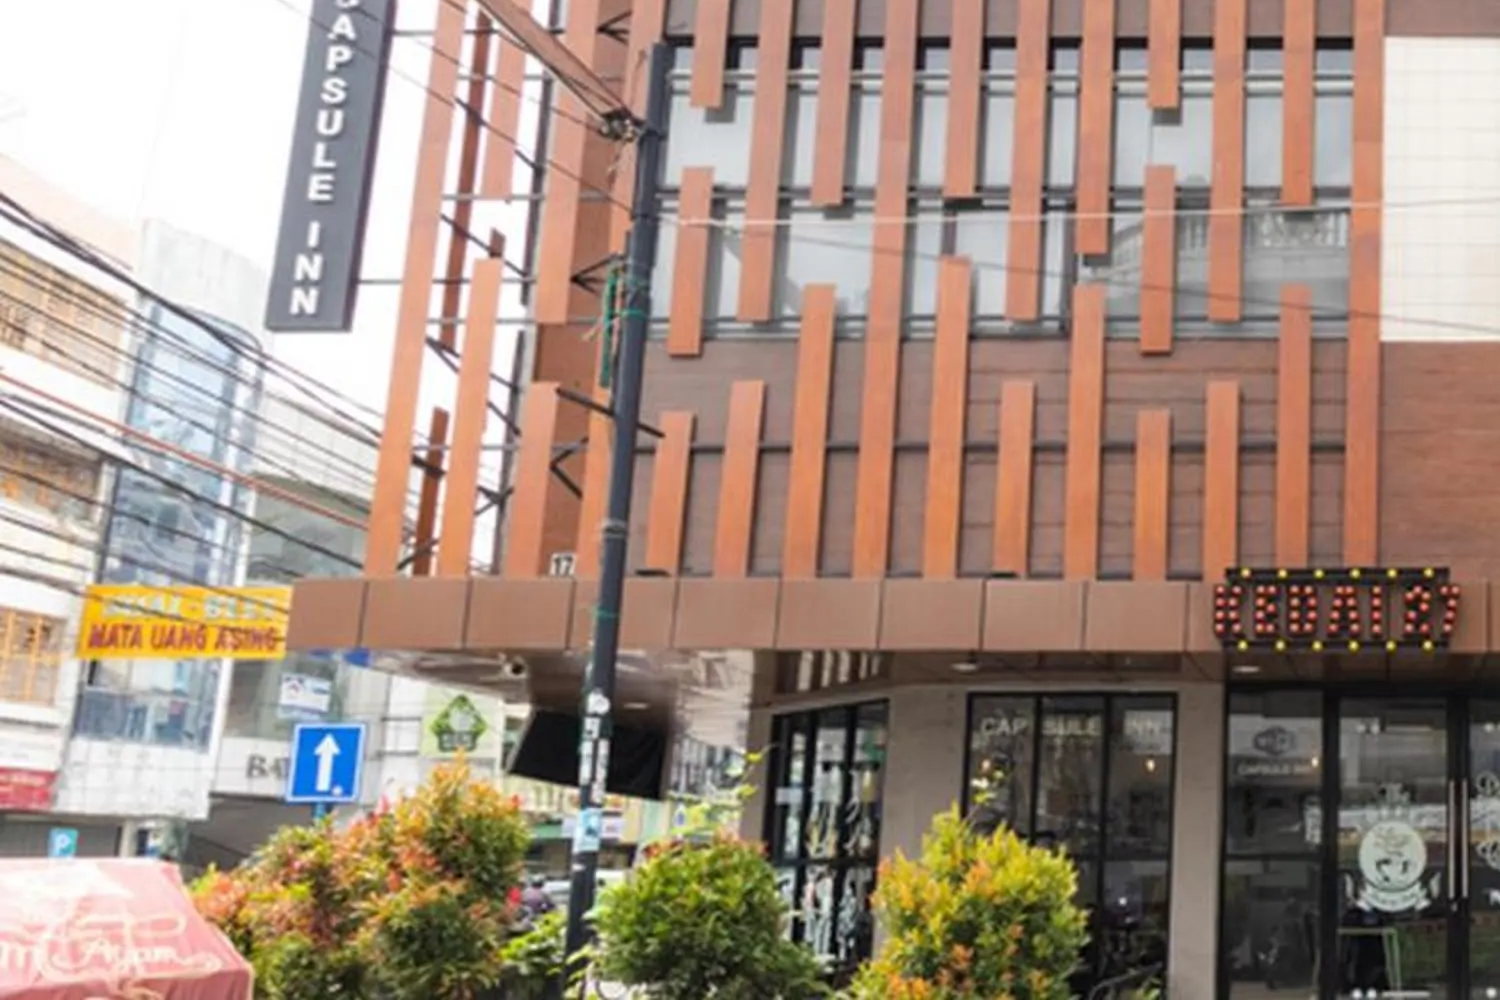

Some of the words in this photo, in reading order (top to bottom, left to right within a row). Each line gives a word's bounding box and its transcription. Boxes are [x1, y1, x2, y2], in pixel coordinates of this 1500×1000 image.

[289, 221, 323, 315] INN
[88, 623, 143, 650] MATA
[150, 624, 208, 650] UANG
[214, 625, 278, 651] ASING
[1214, 583, 1384, 640] KEDAI
